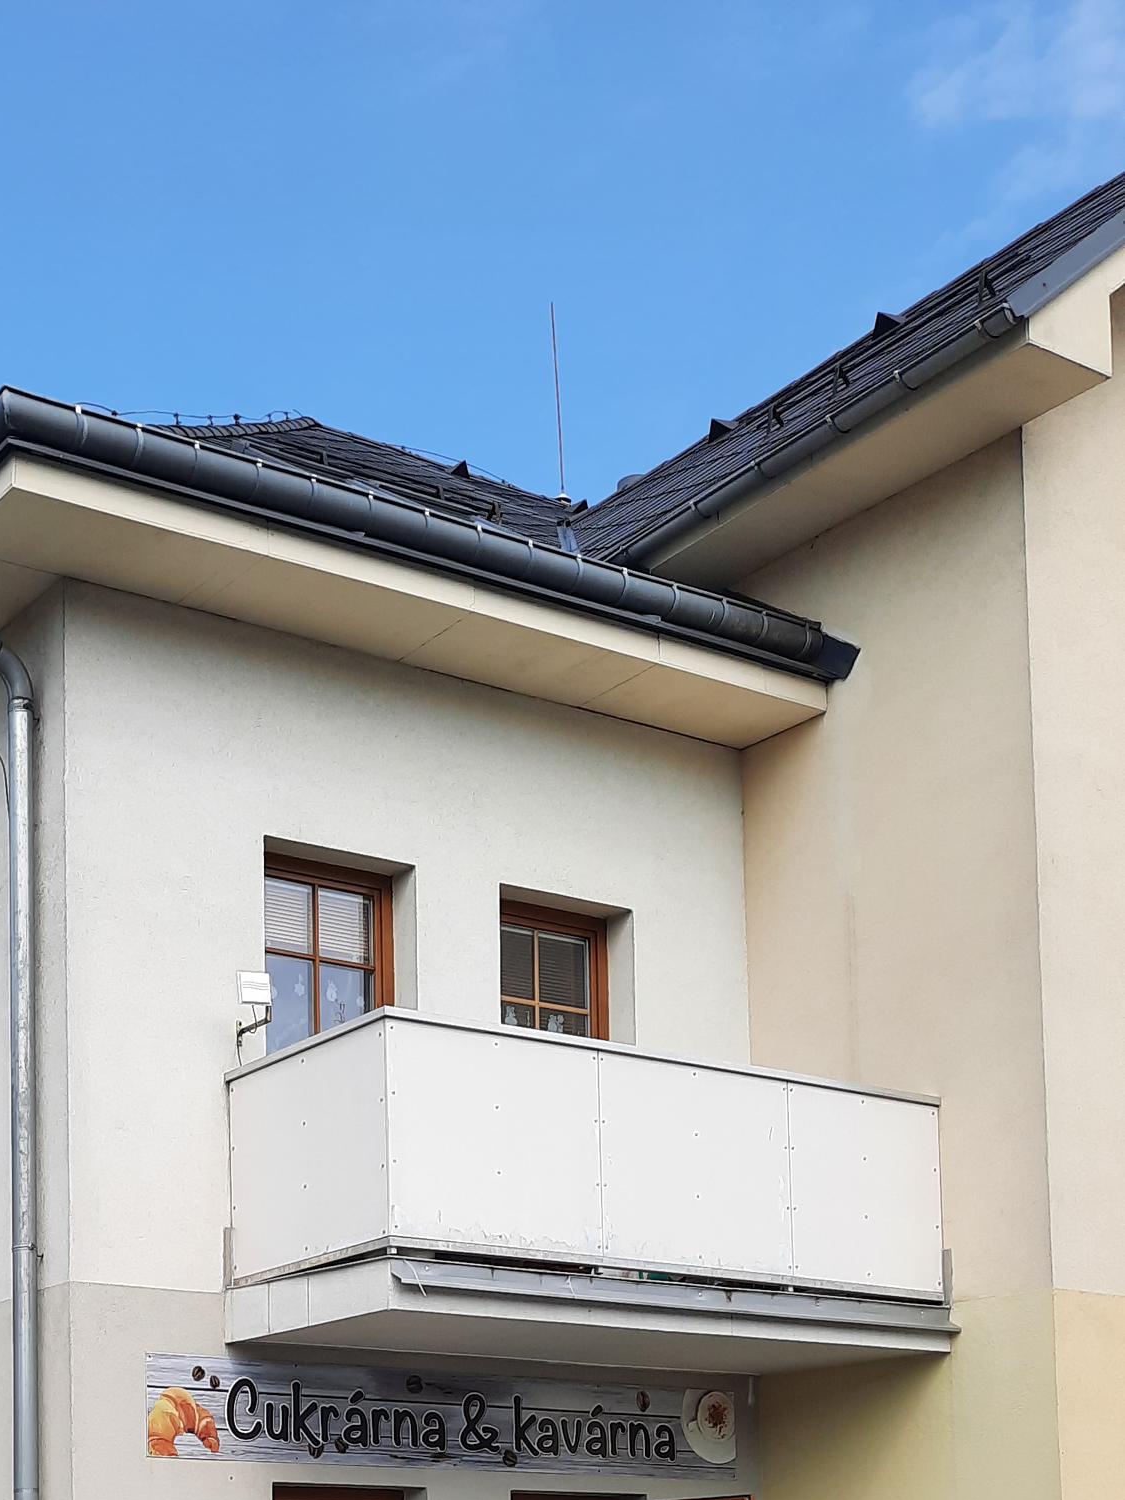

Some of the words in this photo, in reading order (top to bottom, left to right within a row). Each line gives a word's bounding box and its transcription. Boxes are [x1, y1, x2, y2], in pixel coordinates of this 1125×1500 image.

[226, 1377, 446, 1451] Cukrárna
[460, 1393, 501, 1453] &
[513, 1394, 675, 1462] kavárna
